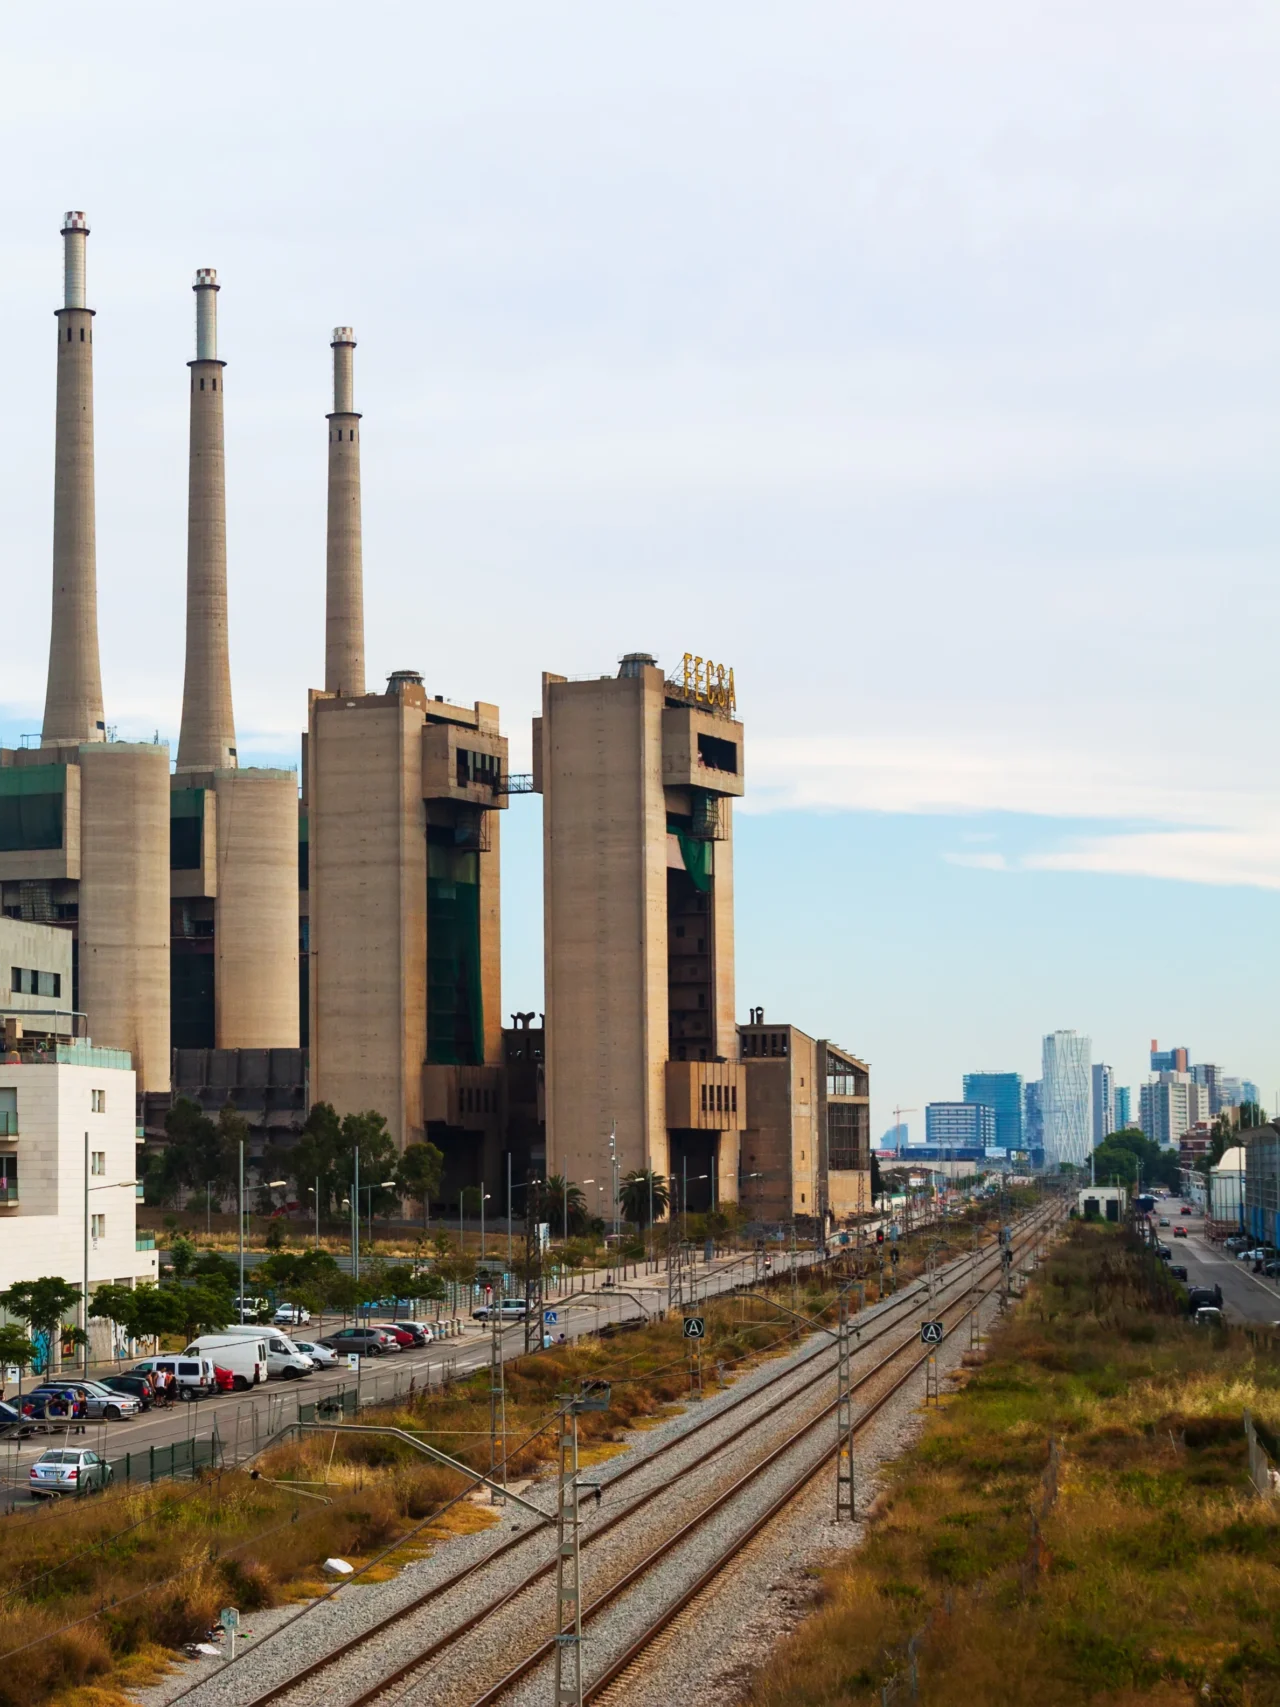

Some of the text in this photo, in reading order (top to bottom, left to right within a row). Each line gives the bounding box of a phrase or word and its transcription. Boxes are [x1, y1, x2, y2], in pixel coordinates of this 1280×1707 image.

[683, 652, 737, 712] FECSA
[688, 1320, 700, 1334] A
[926, 1325, 938, 1339] A
